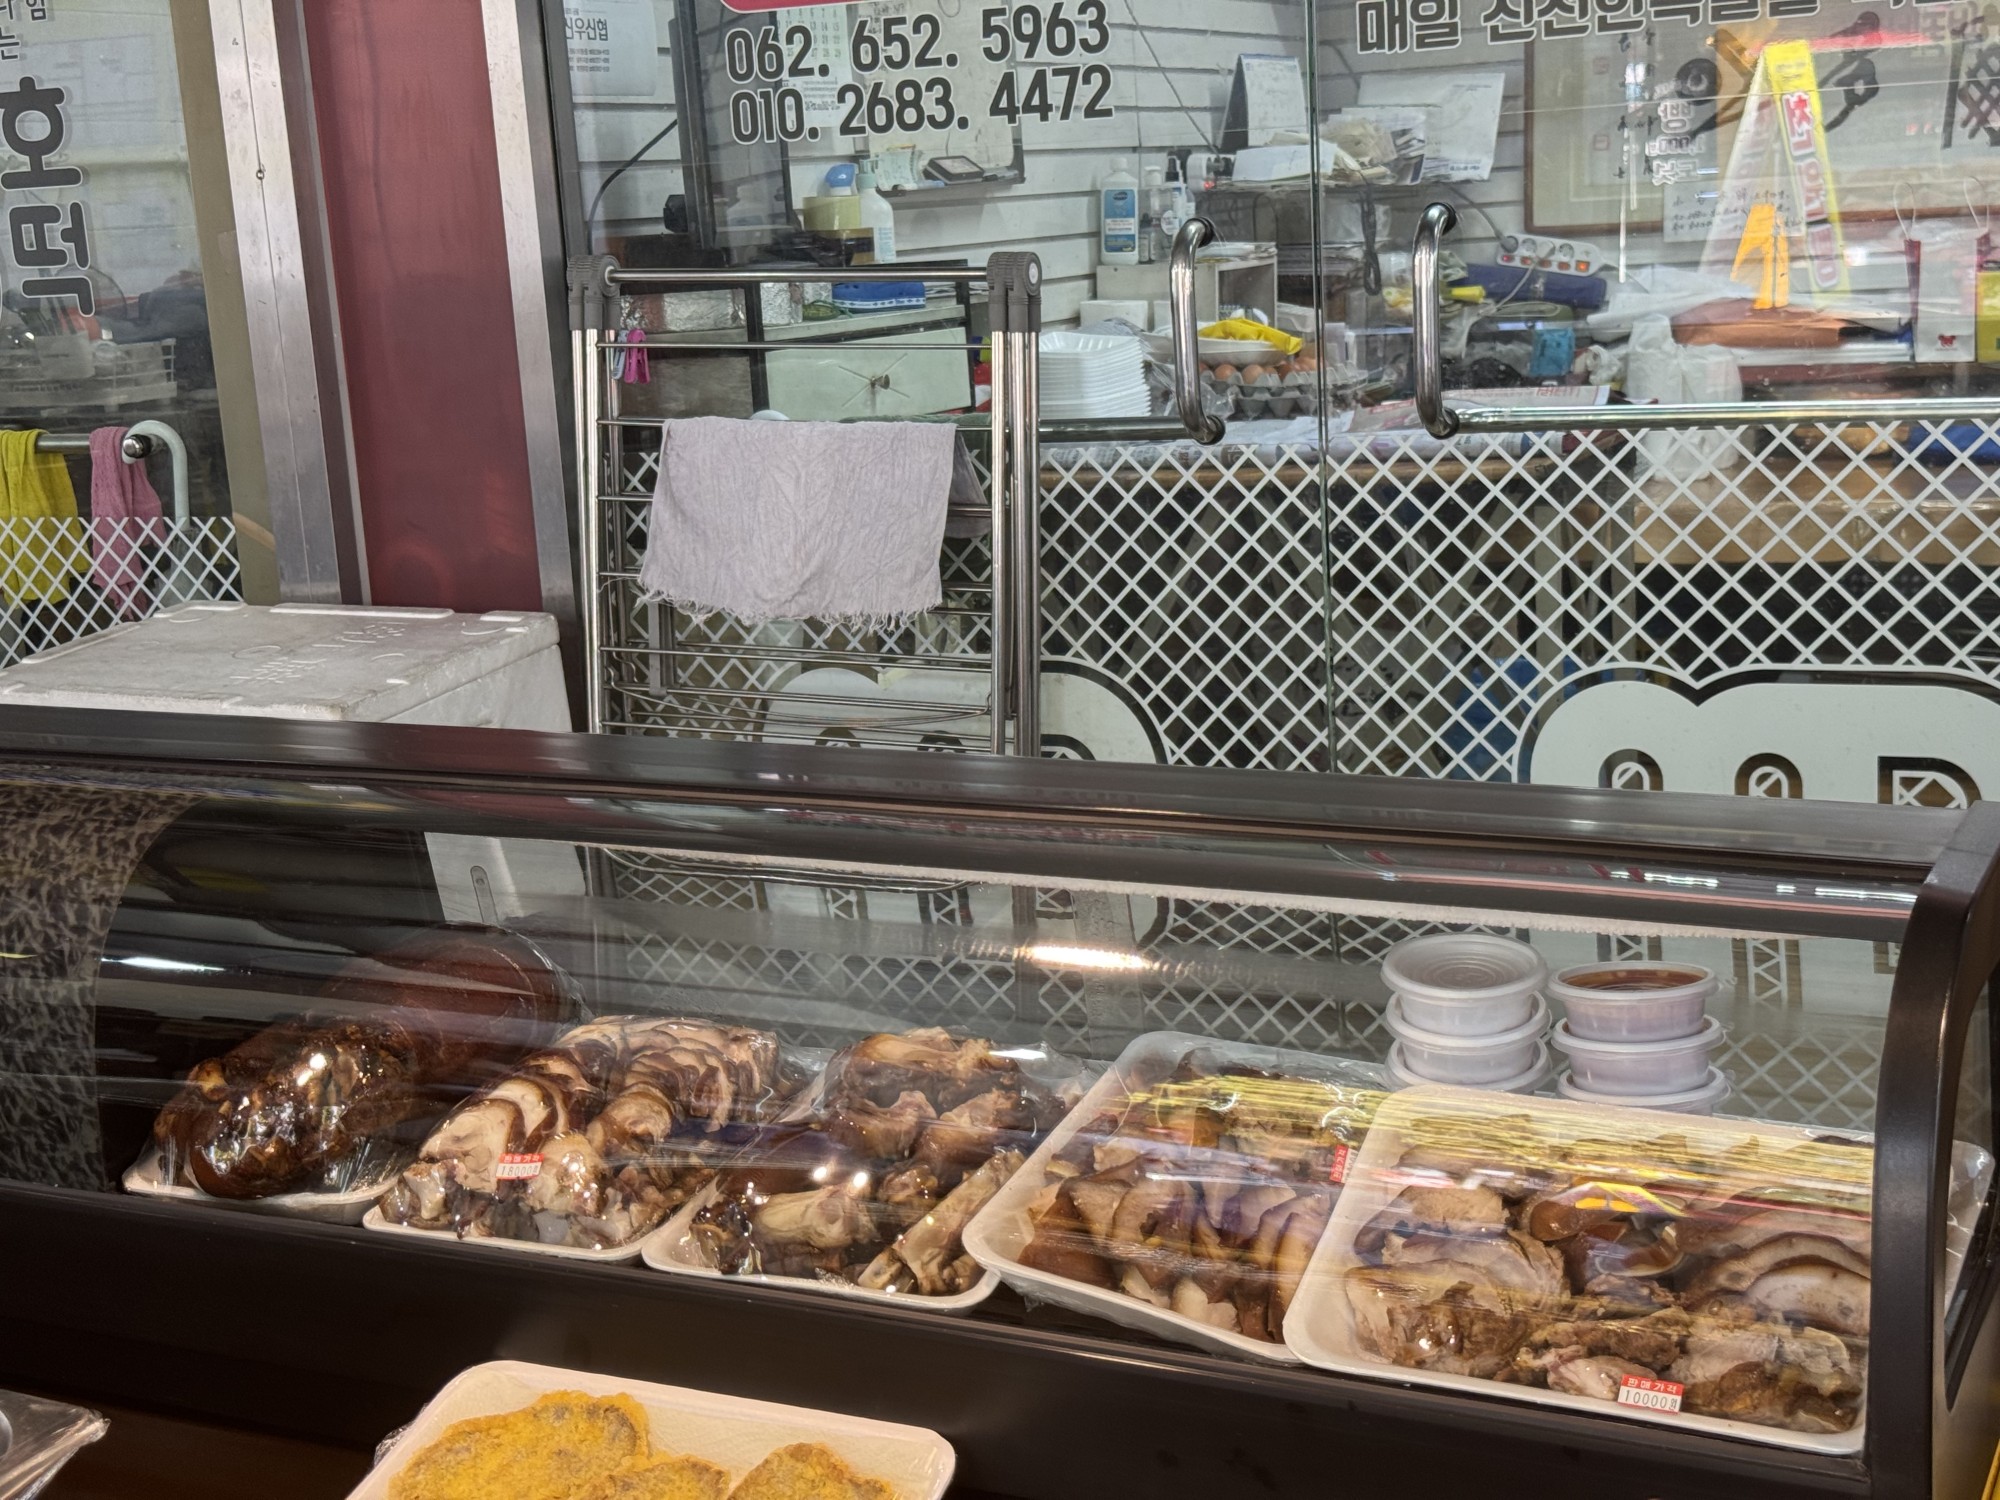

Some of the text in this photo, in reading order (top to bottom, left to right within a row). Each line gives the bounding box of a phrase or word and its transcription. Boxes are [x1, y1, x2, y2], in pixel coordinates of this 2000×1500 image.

[726, 25, 830, 83] 062.
[852, 14, 958, 74] 652.
[982, 0, 1109, 62] 5963
[1357, 0, 1461, 54] 매일
[732, 88, 820, 144] 010.
[837, 77, 970, 136] 2683.
[989, 63, 1114, 125] 4472
[1625, 1390, 1678, 1410] 10000원
[1627, 1377, 1678, 1394] 판매가격
